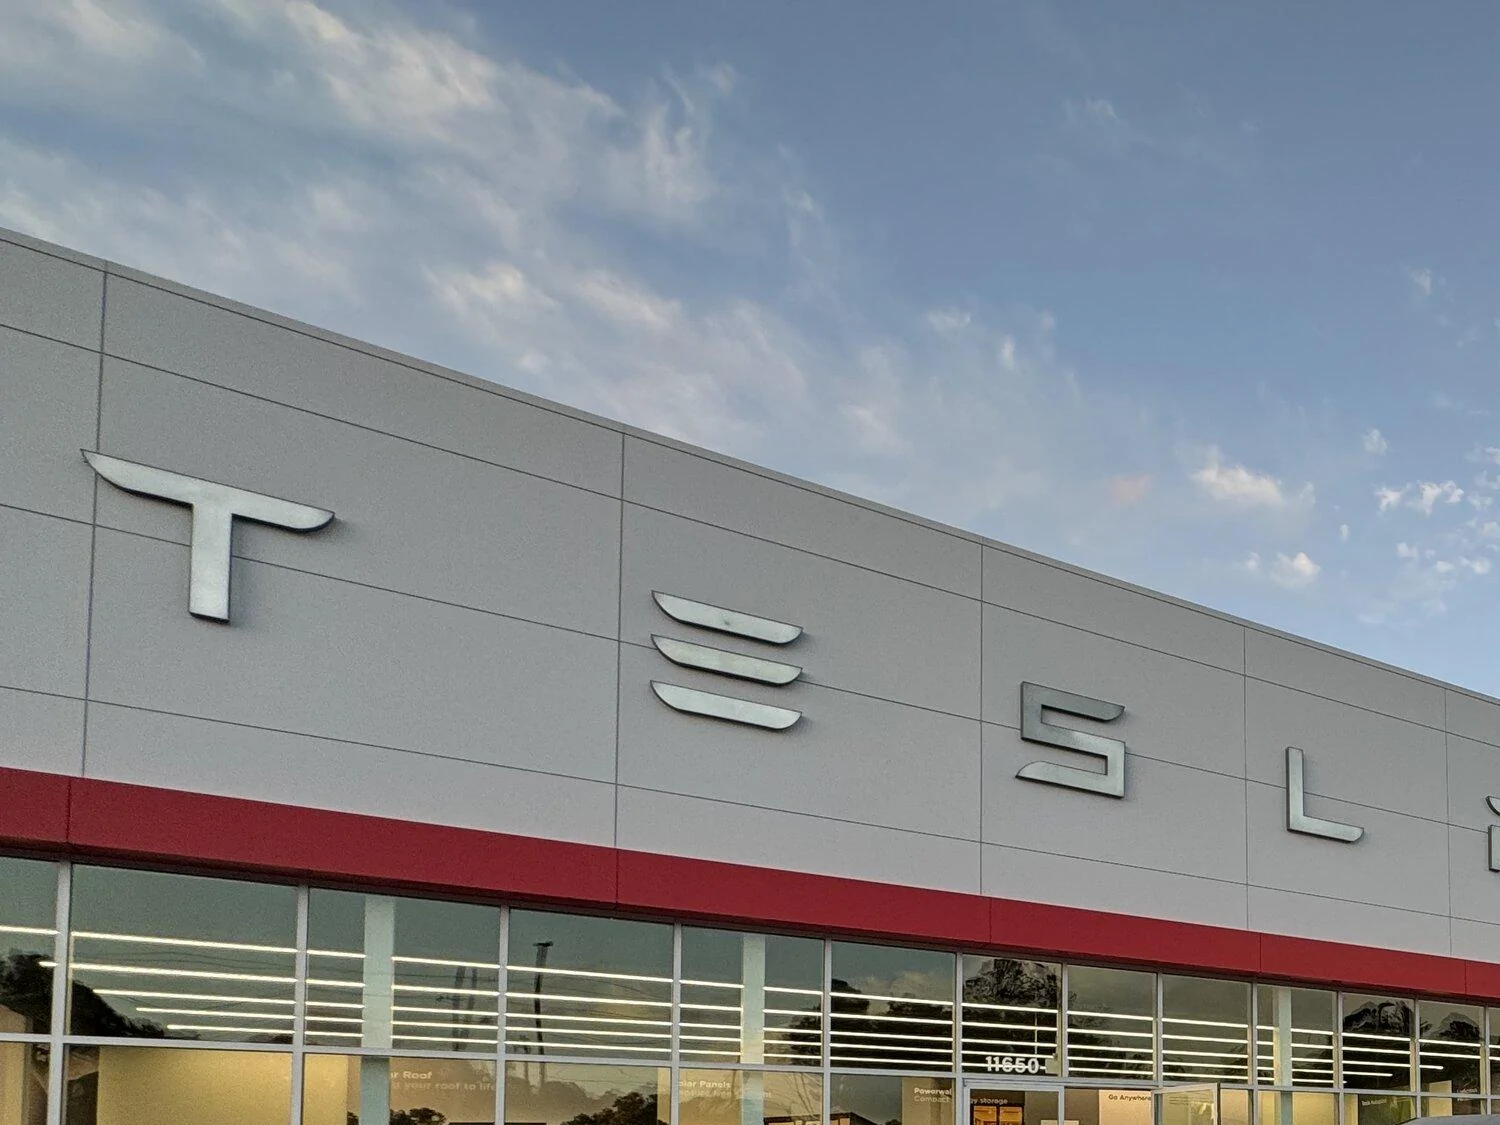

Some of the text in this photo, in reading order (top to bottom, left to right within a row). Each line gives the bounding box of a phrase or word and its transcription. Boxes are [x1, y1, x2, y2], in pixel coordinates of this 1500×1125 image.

[985, 1056, 1040, 1074] 11650
[403, 1070, 432, 1080] Roof
[699, 1080, 731, 1089] Panels
[980, 1097, 1008, 1106] storage
